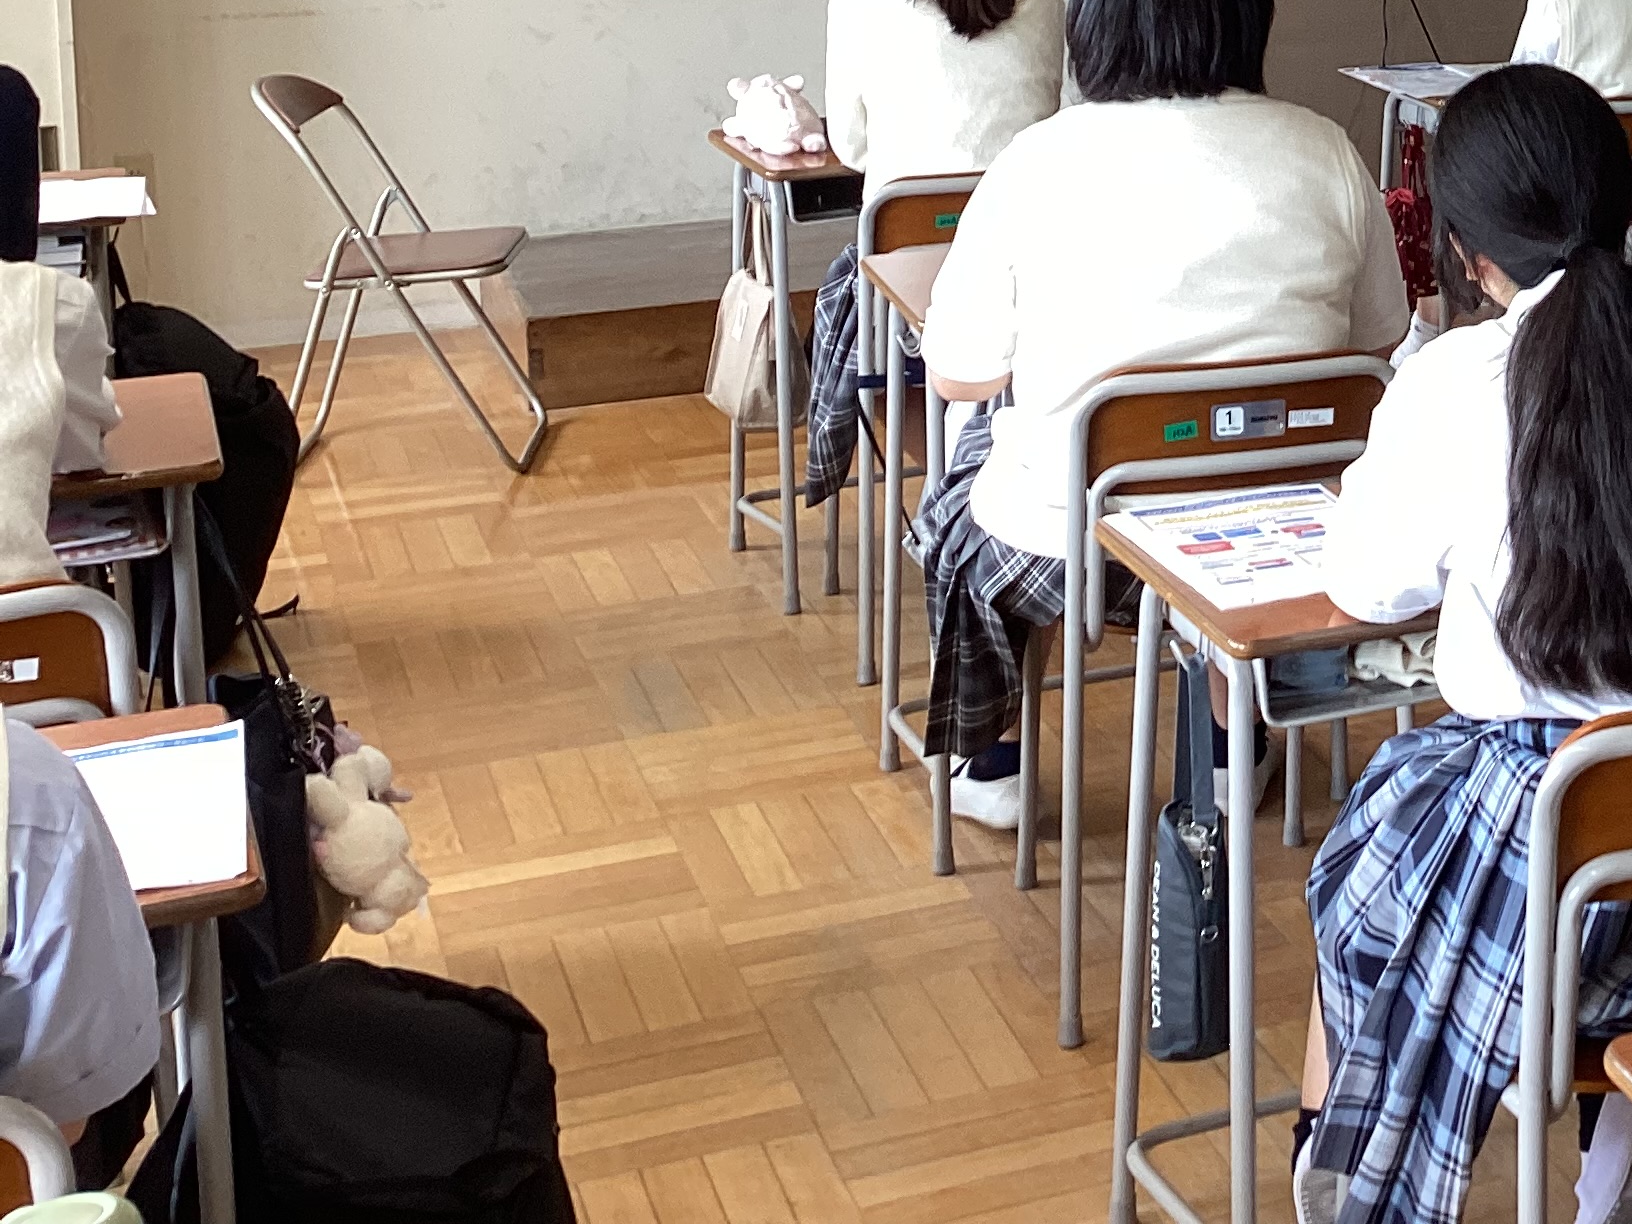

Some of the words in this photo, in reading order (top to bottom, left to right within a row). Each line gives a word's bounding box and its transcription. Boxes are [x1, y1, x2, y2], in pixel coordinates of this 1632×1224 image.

[1225, 410, 1232, 426] 1
[1151, 860, 1161, 922] DEAN
[1151, 943, 1162, 1029] DELUCA
